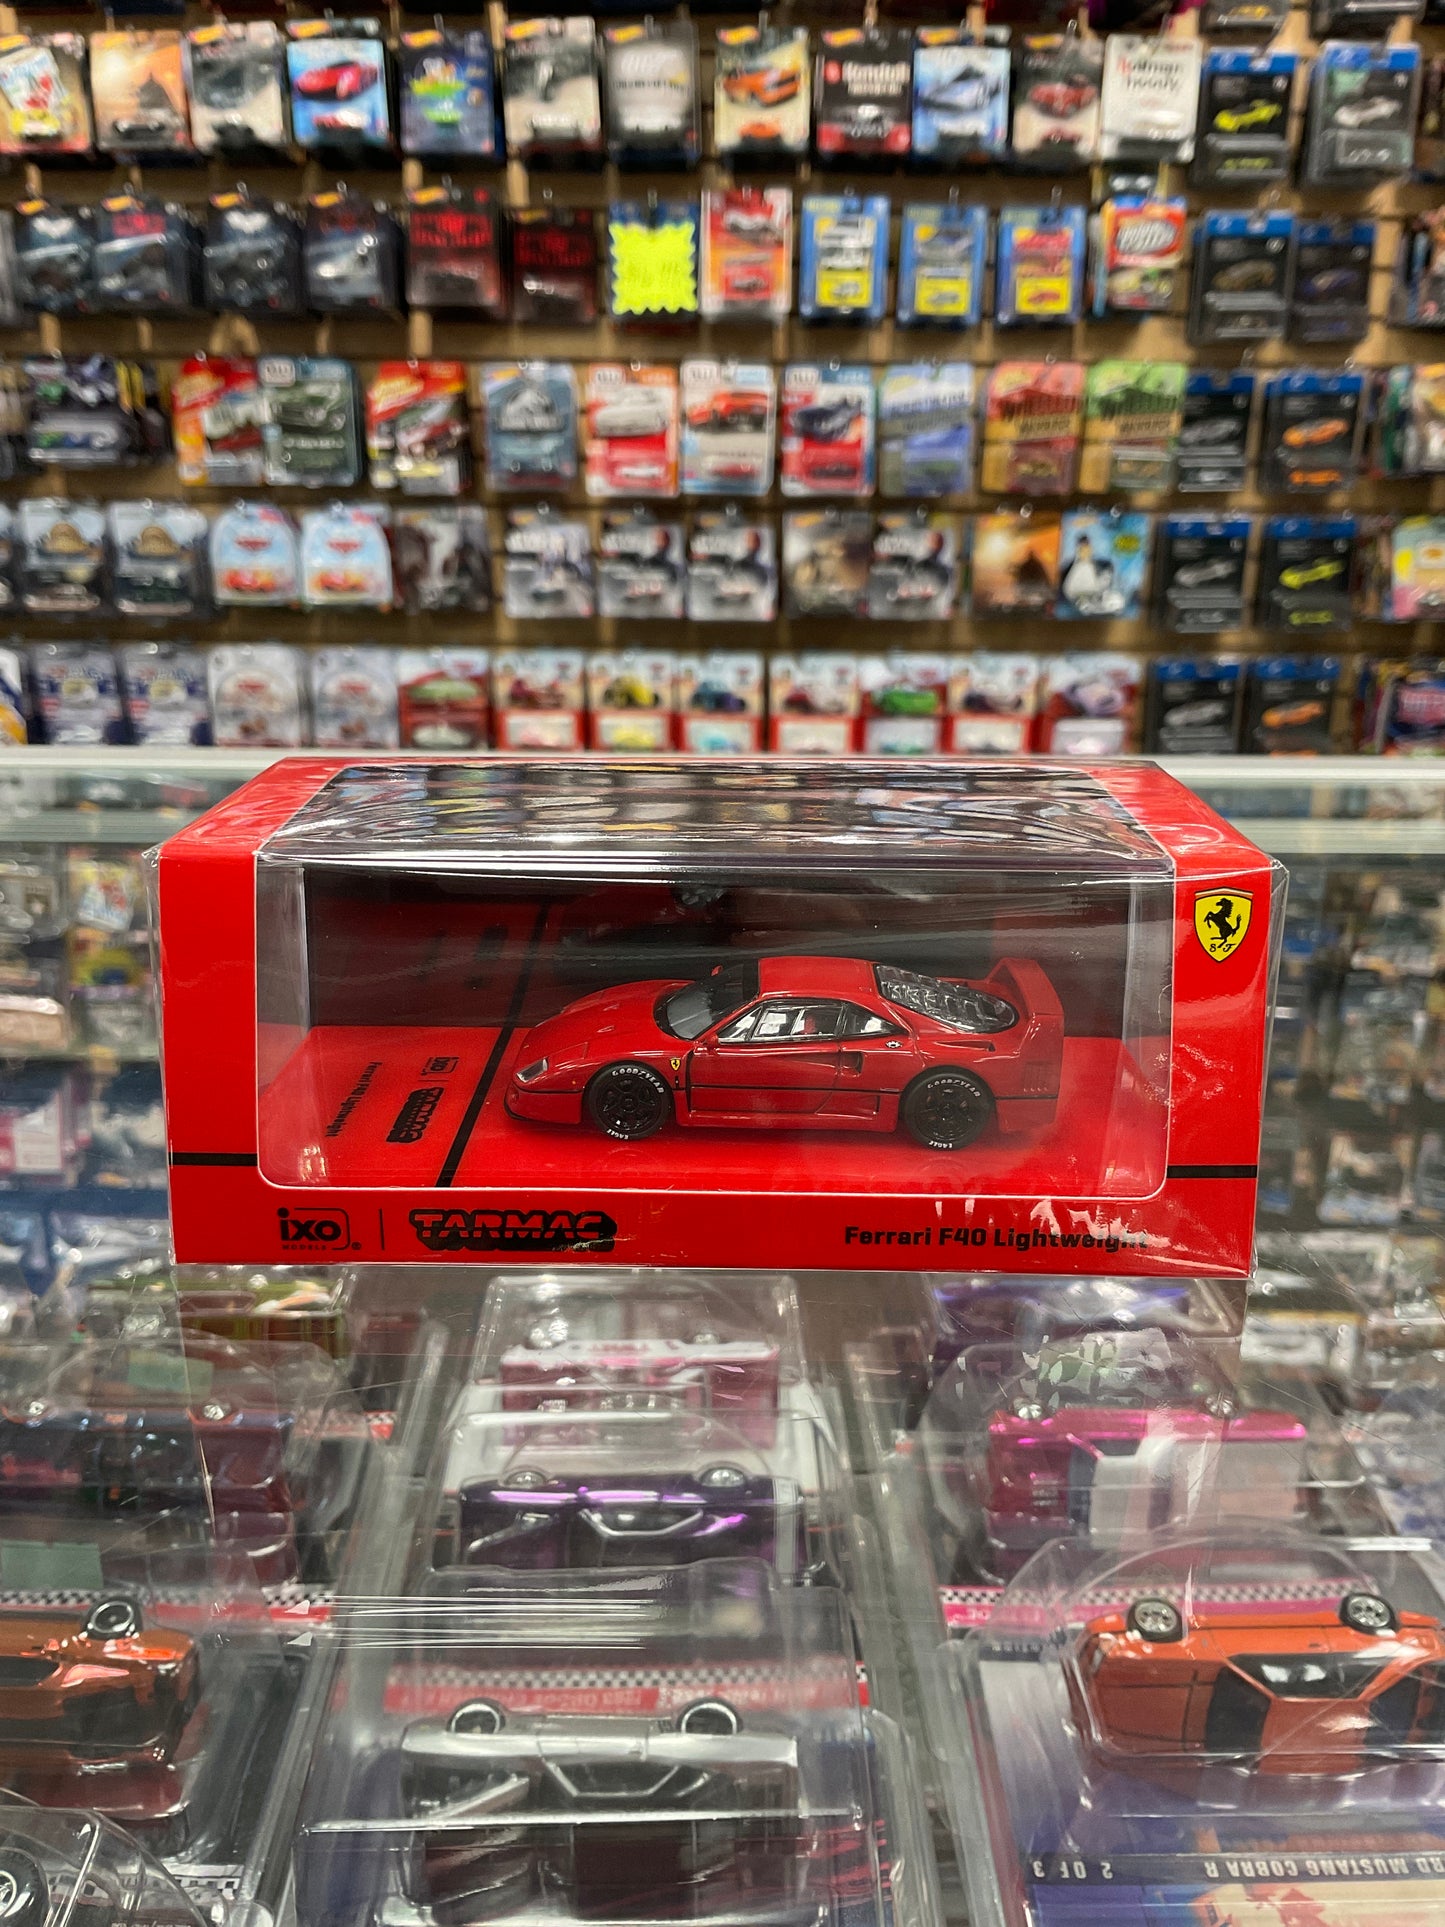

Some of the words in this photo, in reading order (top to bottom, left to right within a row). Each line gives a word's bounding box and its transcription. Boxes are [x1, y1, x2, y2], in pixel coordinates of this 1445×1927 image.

[1209, 943, 1217, 953] S
[611, 1067, 665, 1094] GOODYEAR
[927, 1078, 982, 1098] GOODYEAR
[606, 1128, 629, 1140] EAGLE
[277, 1207, 342, 1241] ixo
[411, 1210, 613, 1248] TARMAC
[845, 1226, 931, 1245] Ferrari
[939, 1228, 986, 1247] F40
[994, 1228, 1149, 1252] Lightweight
[1033, 1861, 1045, 1879] 3
[1060, 1861, 1087, 1879] OF
[1101, 1862, 1113, 1880] 2
[1205, 1862, 1219, 1878] R
[1229, 1861, 1298, 1878] COBRA
[1308, 1858, 1410, 1876] MUSTANG
